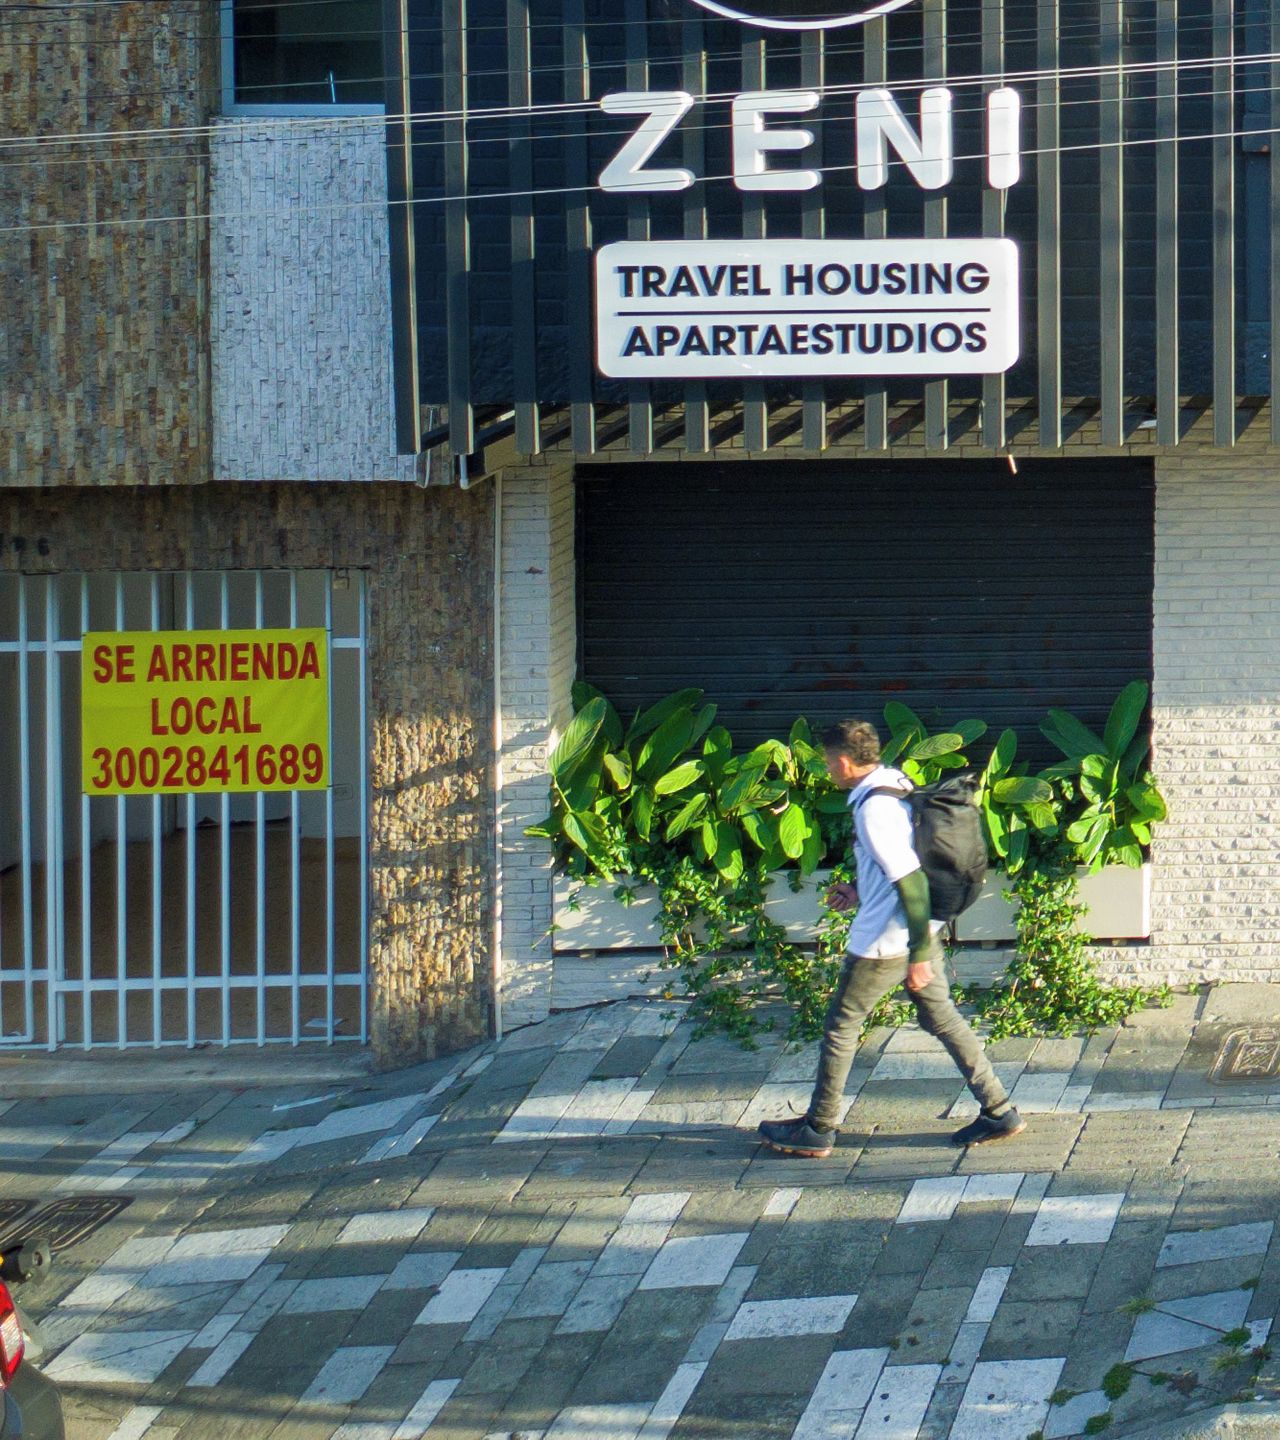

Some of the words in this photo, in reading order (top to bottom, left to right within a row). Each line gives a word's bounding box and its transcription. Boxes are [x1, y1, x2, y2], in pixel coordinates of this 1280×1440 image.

[599, 87, 1021, 191] ZENI
[614, 264, 771, 298] TRAVEL
[783, 263, 991, 296] HOUSING
[619, 322, 988, 358] APARTAESTUDIOS
[93, 645, 135, 683] SE
[147, 641, 321, 683] ARRIENDA
[151, 696, 262, 736] LOCAL
[91, 743, 324, 789] 3002841689
